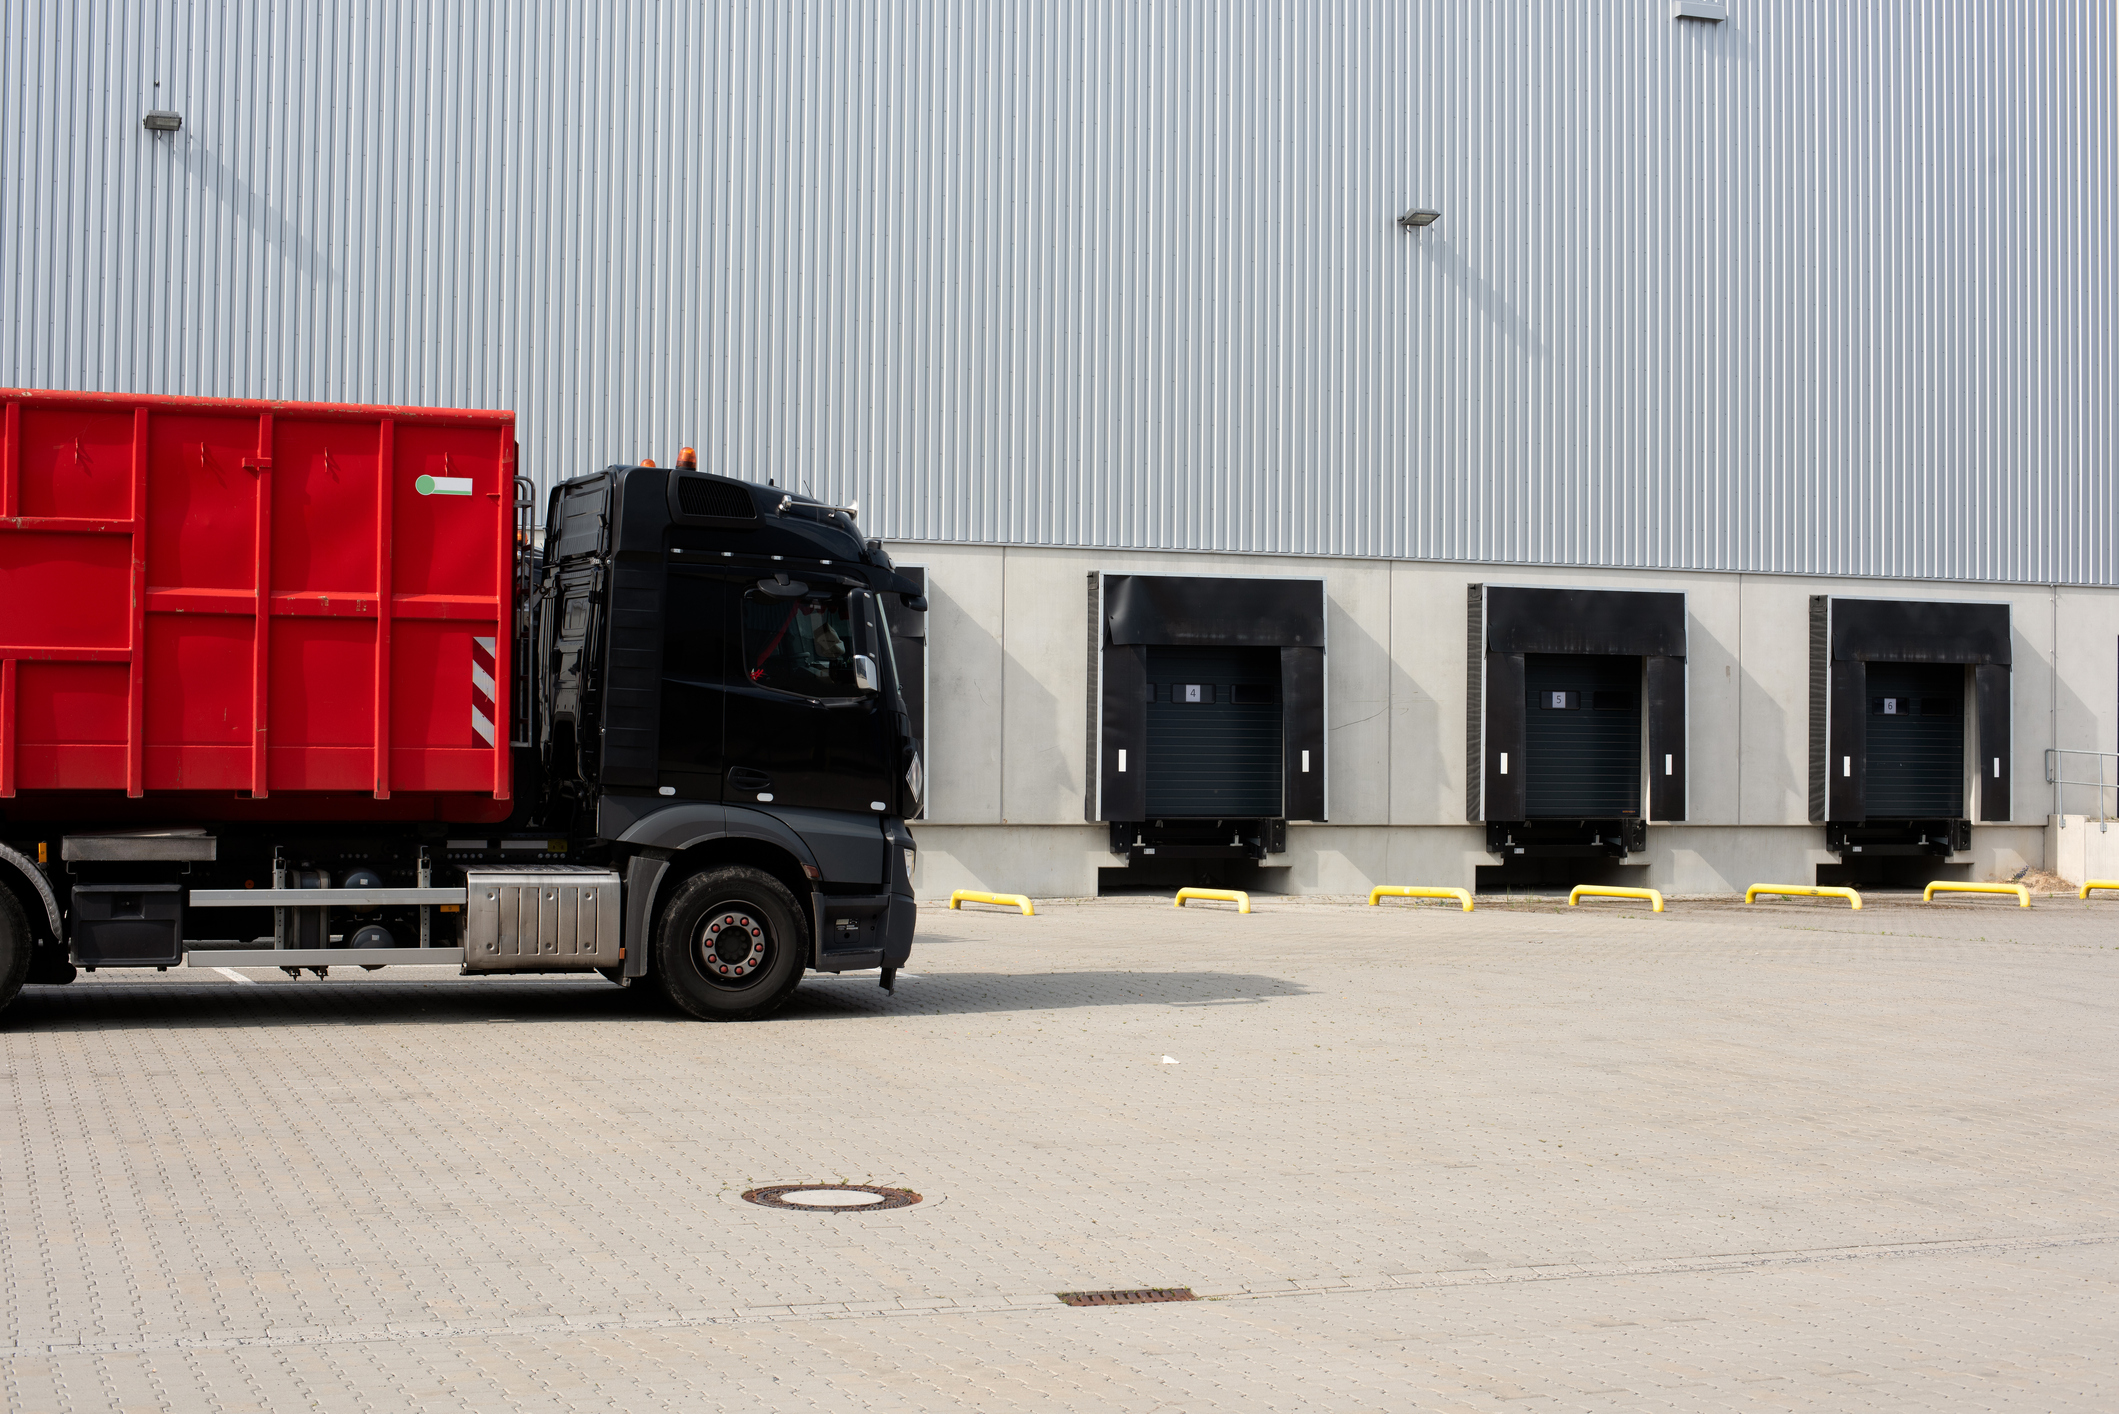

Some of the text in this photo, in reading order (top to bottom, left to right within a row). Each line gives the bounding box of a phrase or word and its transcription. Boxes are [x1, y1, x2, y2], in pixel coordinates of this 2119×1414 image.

[1190, 688, 1196, 697] 4
[1556, 695, 1562, 704] 5
[1887, 702, 1893, 710] 6
[734, 883, 754, 892] 22.5
